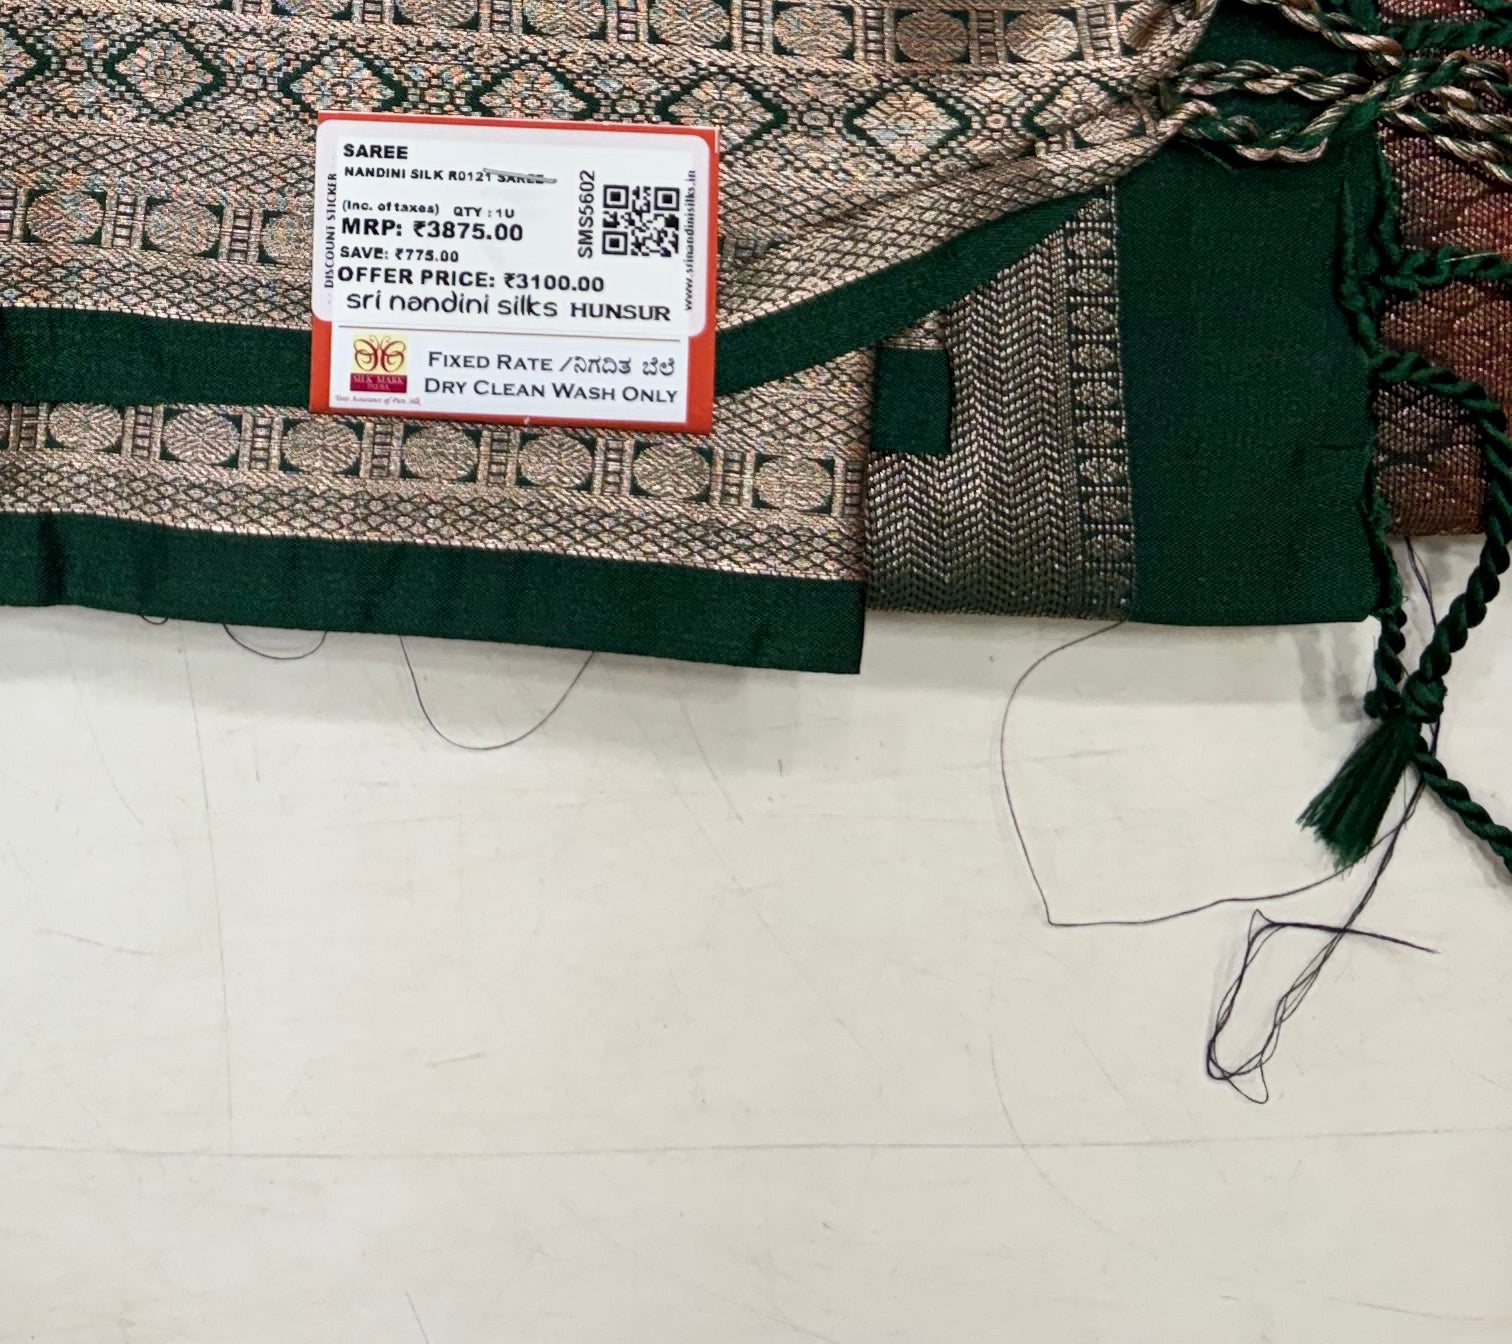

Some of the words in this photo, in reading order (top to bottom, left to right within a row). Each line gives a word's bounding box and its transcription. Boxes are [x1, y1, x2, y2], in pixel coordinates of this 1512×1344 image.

[343, 143, 408, 160] SAREE
[344, 166, 406, 180] NANDINI
[410, 168, 443, 181] SILK
[326, 173, 336, 220] STICKER
[342, 200, 373, 213] (Inc.
[453, 206, 482, 218] QTY
[578, 170, 595, 259] SMS5602
[341, 217, 402, 237] MRP:
[413, 221, 523, 241] ₹3875.00
[684, 170, 696, 311] www.srinandinisilks.in
[324, 226, 335, 288] DISCOUNT
[340, 246, 389, 260] SAVE:
[395, 248, 459, 263] ₹775.00
[337, 267, 413, 285] OFFER
[421, 269, 495, 288] PRICE:
[504, 273, 605, 293] ₹3100.00
[347, 291, 382, 312] sri
[390, 291, 489, 315] nandini
[498, 295, 558, 317] silks
[570, 302, 671, 321] HUNSUR
[428, 351, 490, 369] FIXED
[497, 354, 553, 371] RATE
[424, 378, 467, 395] DRY
[473, 380, 545, 398] CLEAN
[552, 383, 616, 401] WASH
[622, 386, 678, 404] ONLY
